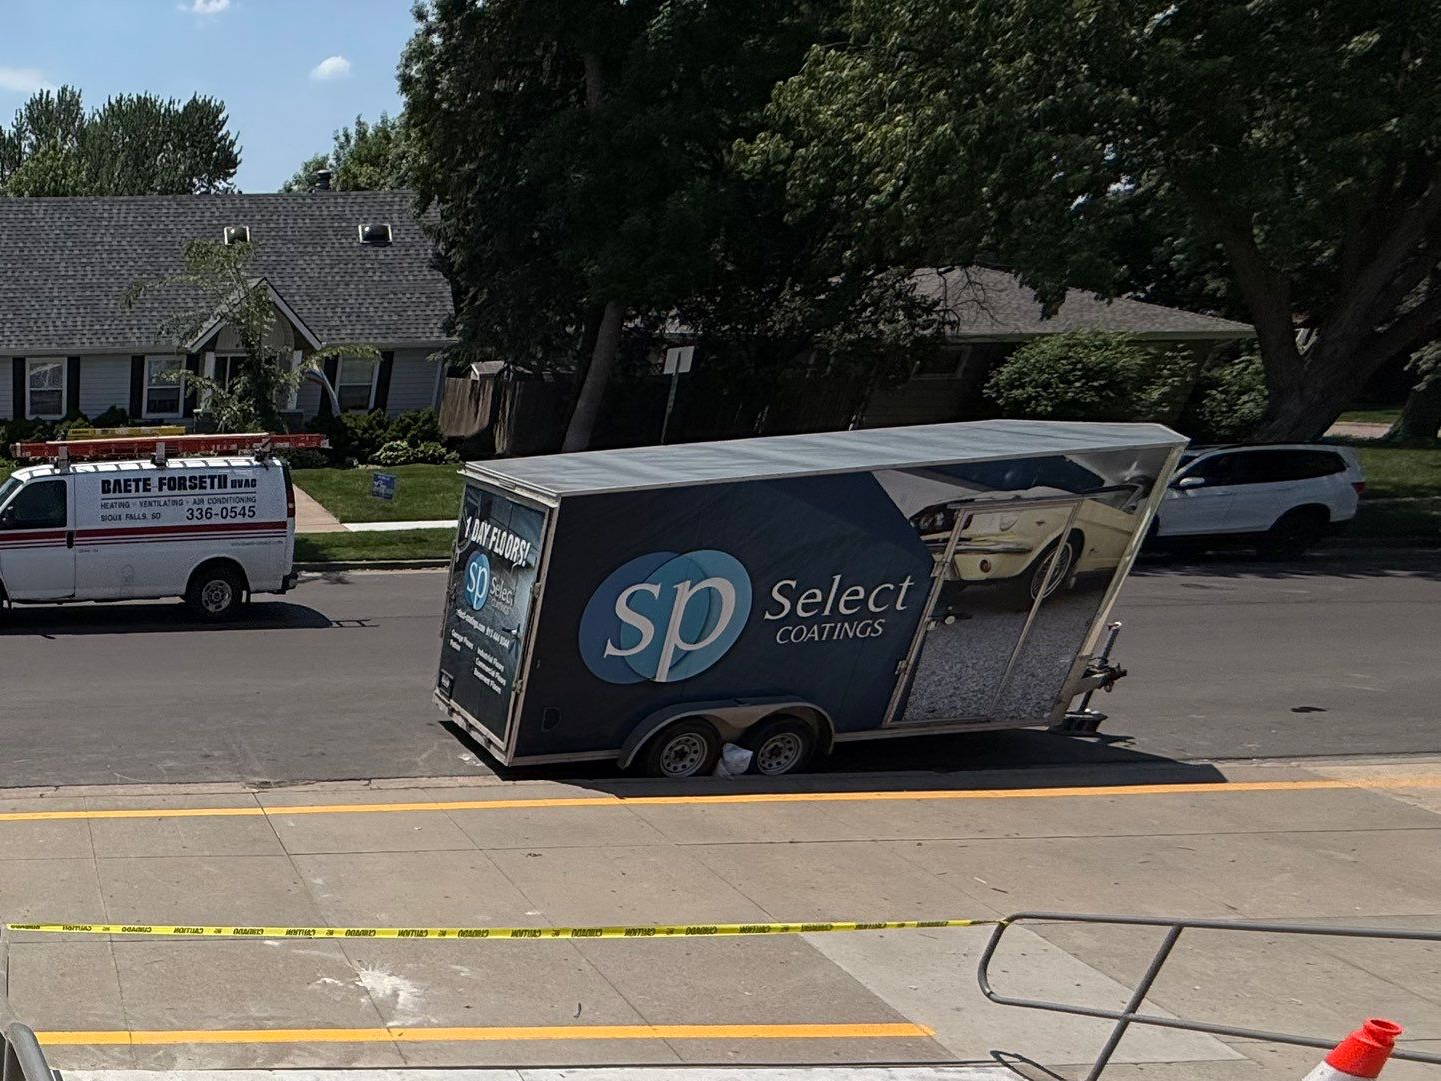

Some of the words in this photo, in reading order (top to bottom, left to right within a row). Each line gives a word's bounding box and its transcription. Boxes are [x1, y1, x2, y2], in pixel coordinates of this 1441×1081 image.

[101, 500, 130, 509] HEATING
[139, 499, 184, 508] VENTILATING
[193, 497, 205, 505] AIR
[208, 496, 257, 505] CONDITIONING
[186, 506, 256, 521] 336-0545
[101, 514, 122, 522] SIOUX
[151, 512, 161, 520] SD
[464, 516, 472, 538] 1
[471, 518, 491, 547] DAY
[488, 526, 531, 568] FLOORS!
[763, 574, 915, 621] Select
[603, 577, 736, 683] sp
[776, 618, 885, 644] COATINGS
